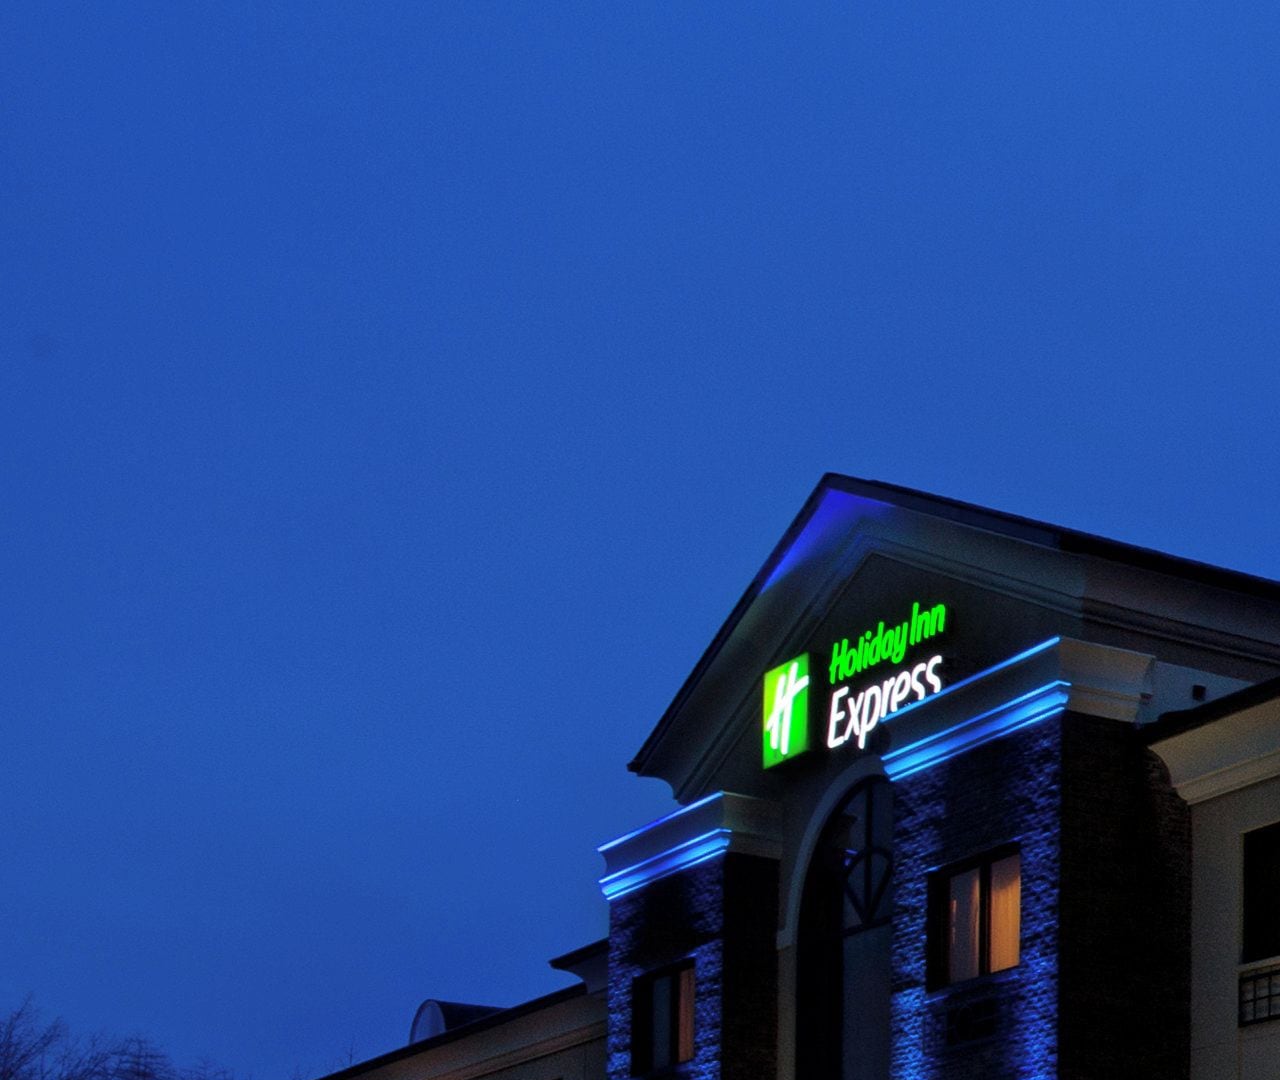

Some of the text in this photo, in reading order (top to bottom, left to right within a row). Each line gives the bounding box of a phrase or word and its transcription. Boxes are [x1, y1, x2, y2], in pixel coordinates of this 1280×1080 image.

[829, 602, 946, 684] Holiday Inn
[827, 655, 942, 749] Express
